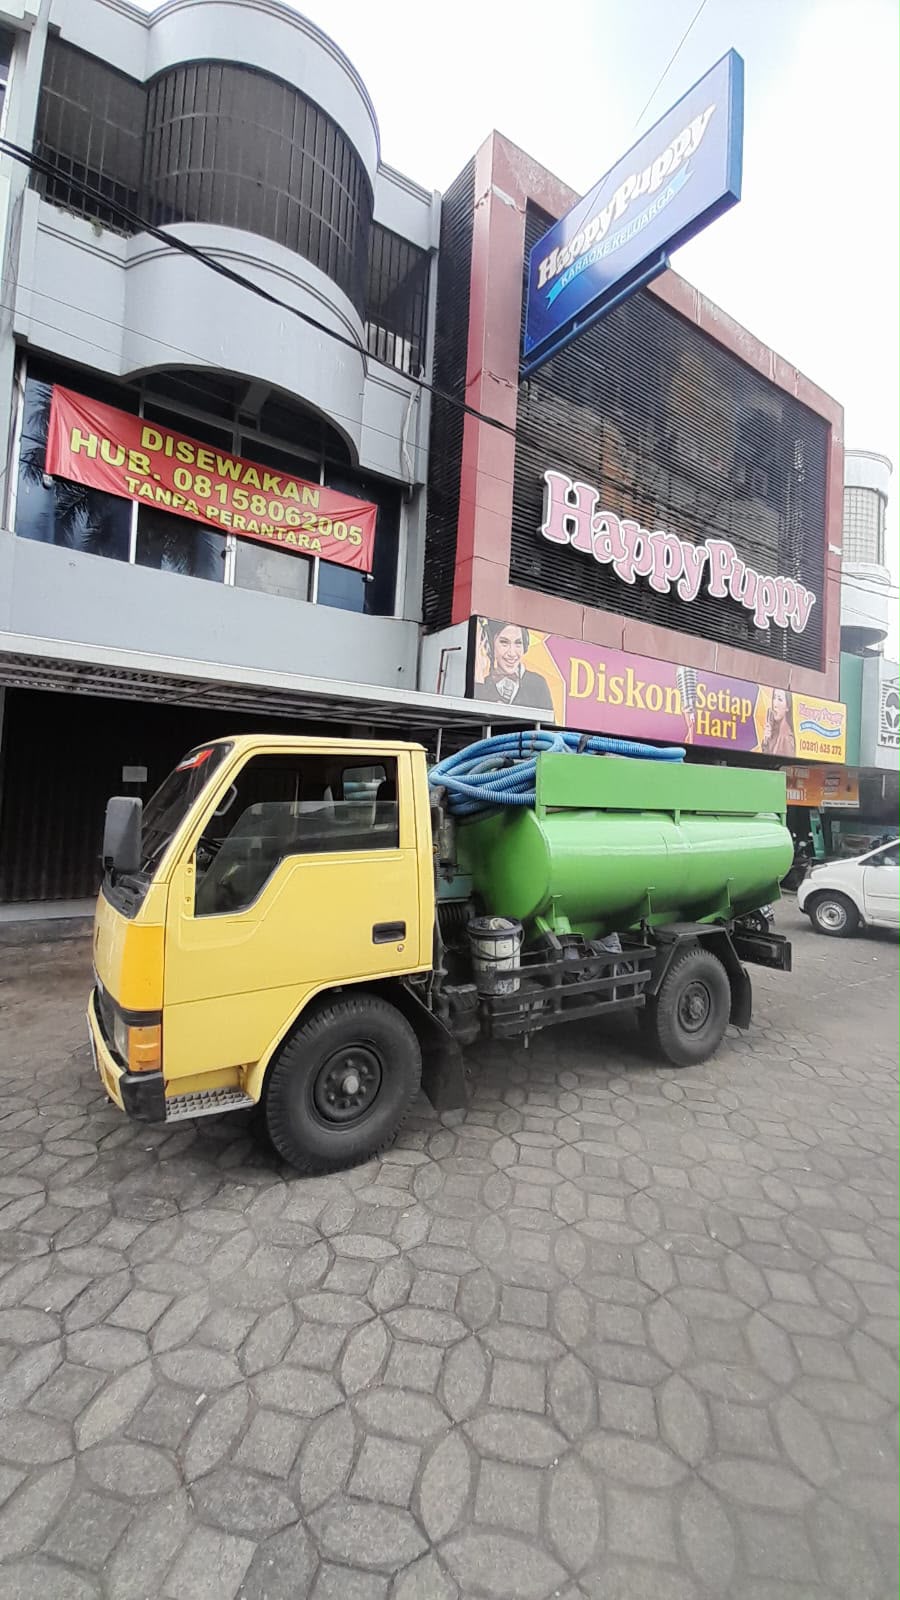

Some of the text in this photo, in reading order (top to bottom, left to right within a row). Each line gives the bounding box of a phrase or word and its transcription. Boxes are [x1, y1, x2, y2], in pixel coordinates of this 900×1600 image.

[537, 103, 717, 289] Happy Puppy
[560, 187, 674, 287] KARAOKE KELUARGA
[70, 428, 363, 547] HUB. 08158062005
[141, 426, 320, 509] DISEWAKAN
[125, 476, 322, 552] TANPA PERANTARA
[541, 471, 816, 633] Happy Puppy
[568, 656, 682, 715] Diskon
[695, 683, 752, 723] Setiap
[696, 709, 737, 740] Hari
